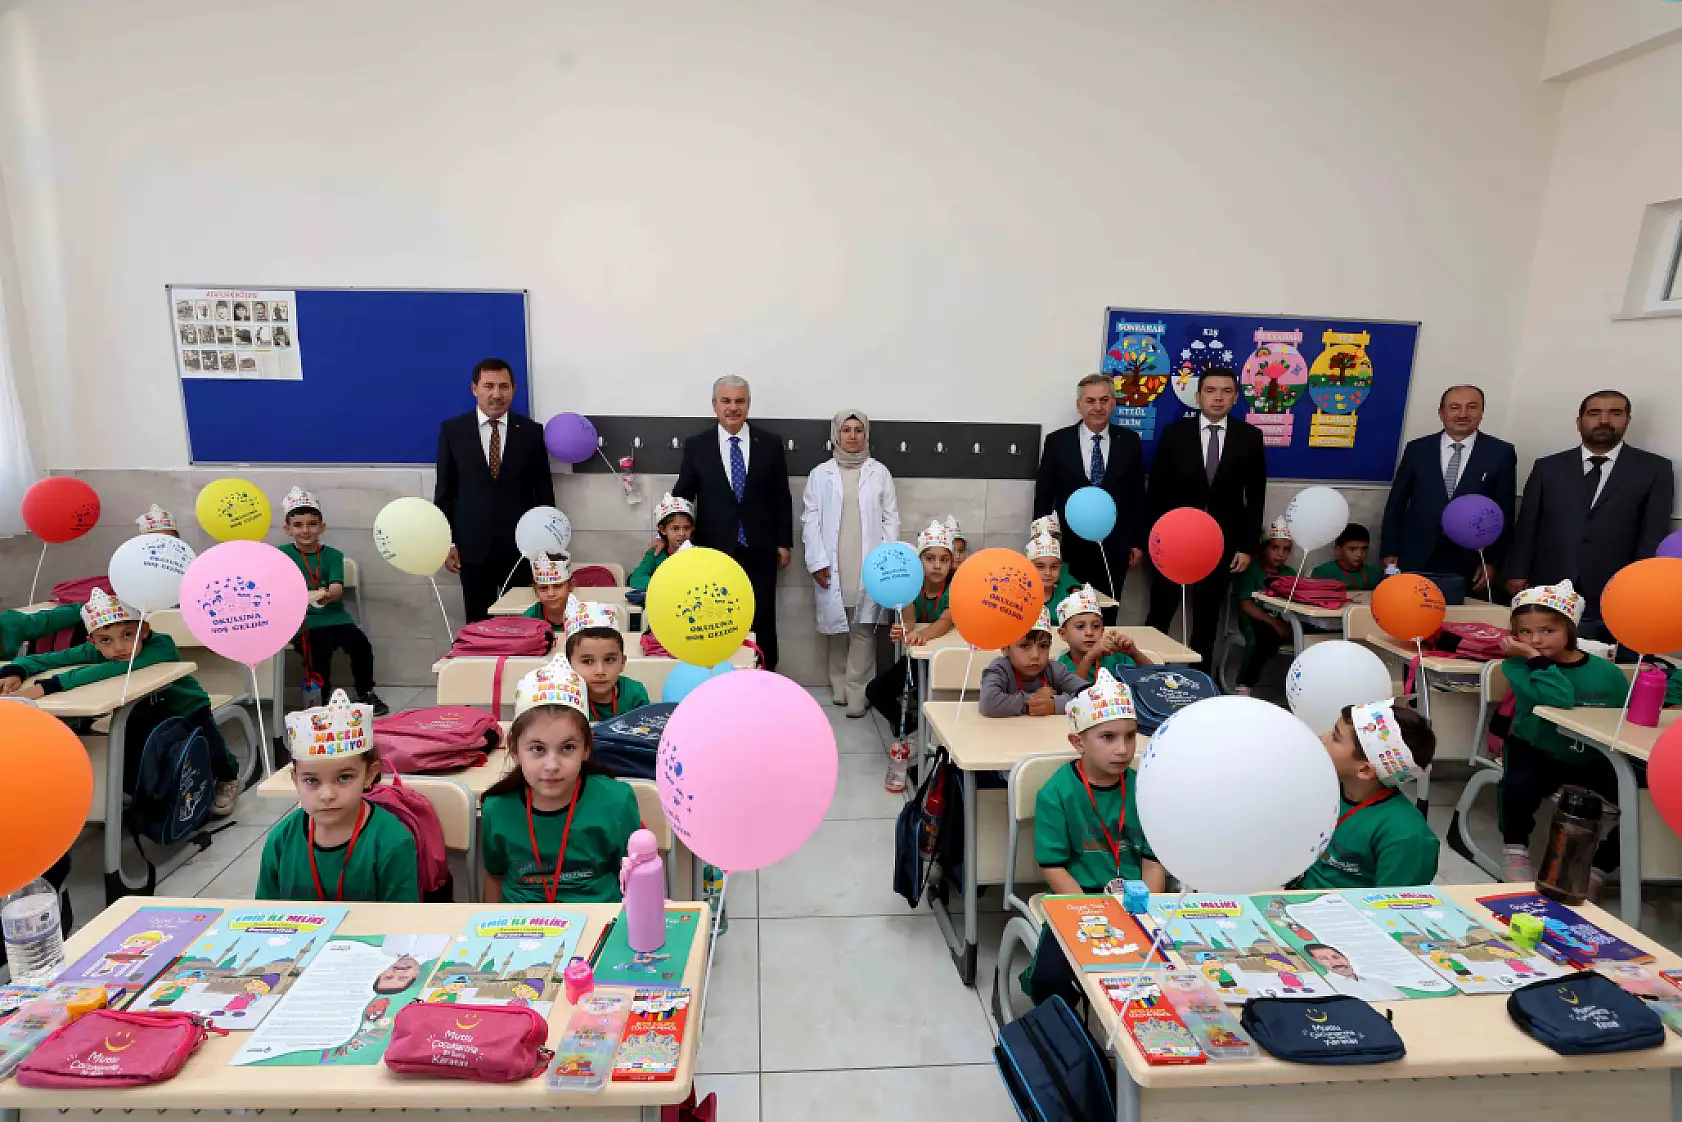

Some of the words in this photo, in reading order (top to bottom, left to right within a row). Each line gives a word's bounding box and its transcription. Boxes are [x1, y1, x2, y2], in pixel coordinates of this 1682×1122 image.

[212, 612, 262, 625] OKULUNA
[690, 619, 734, 632] OKULUNA
[210, 626, 228, 634] HOŞ
[231, 619, 269, 630] GELDİN
[314, 728, 364, 743] MACERA
